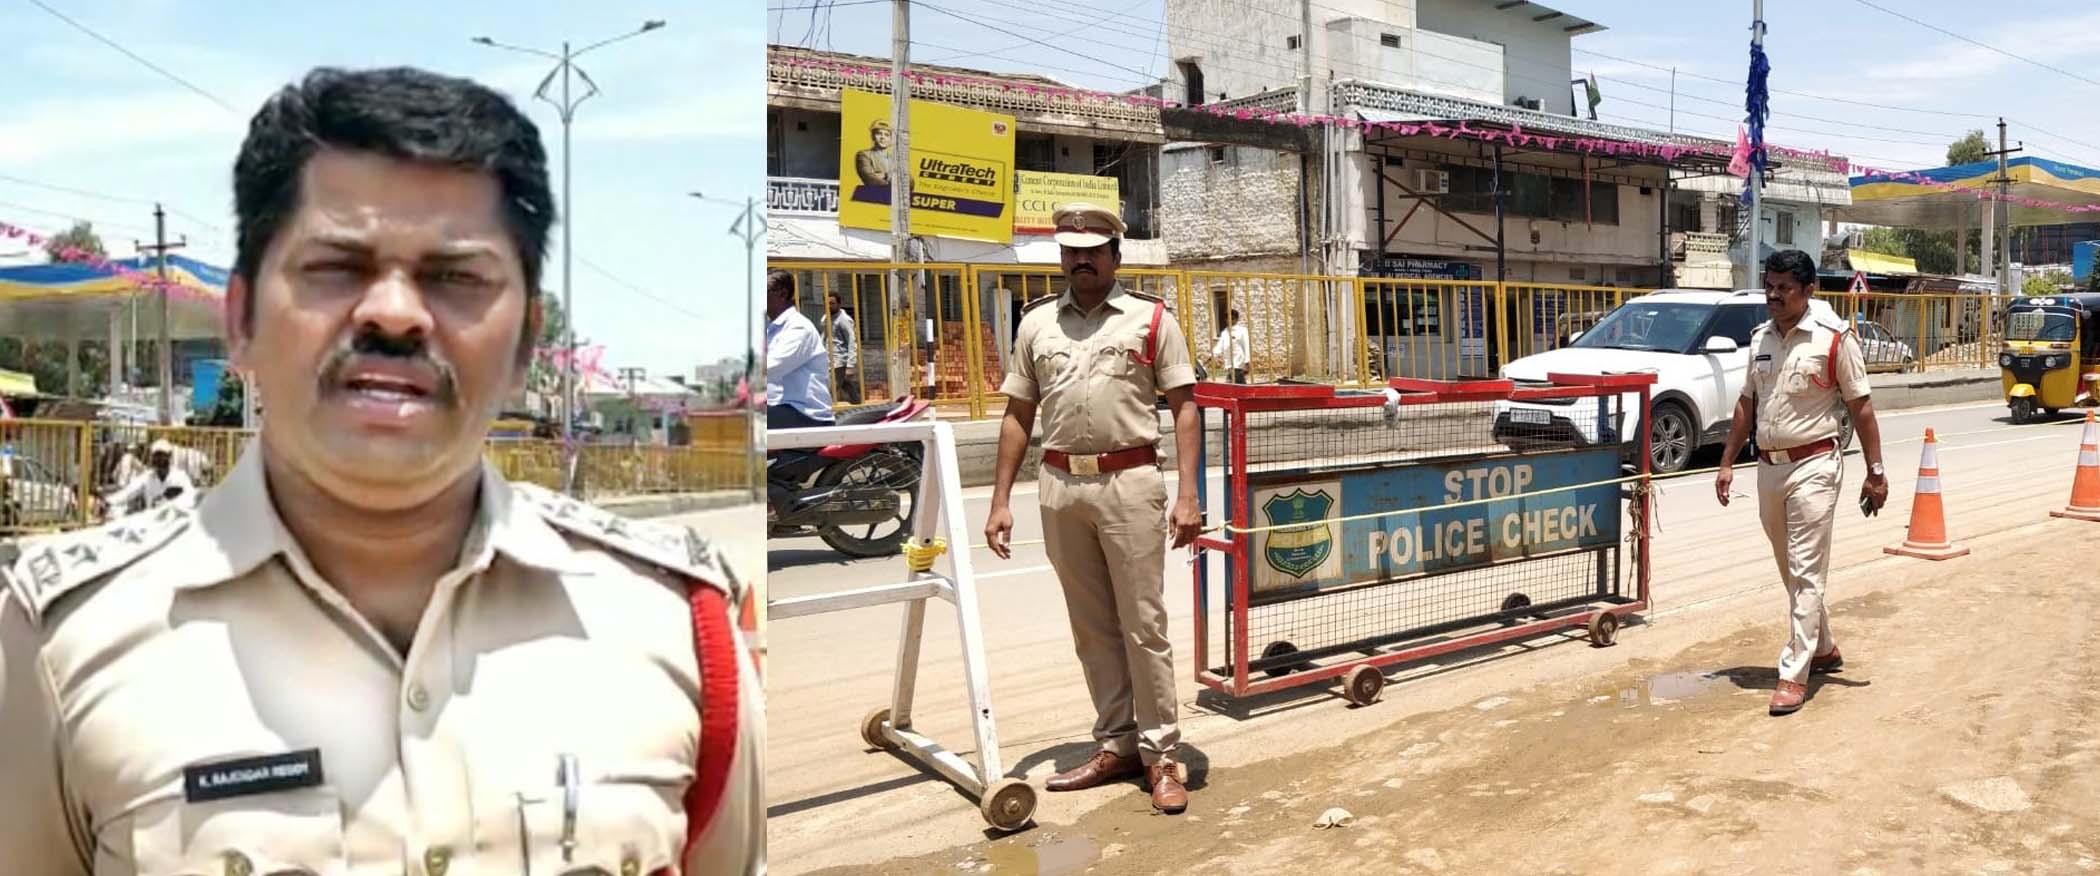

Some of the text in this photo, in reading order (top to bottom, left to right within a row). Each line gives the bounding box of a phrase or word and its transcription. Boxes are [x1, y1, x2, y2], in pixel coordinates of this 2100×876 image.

[920, 158, 996, 179] UltraTech
[912, 196, 956, 210] SUPER
[1023, 200, 1046, 212] CCI
[1392, 259, 1406, 268] SAI
[1407, 260, 1448, 269] PHARMACY
[1444, 464, 1533, 503] STOP
[1369, 520, 1487, 569] POLICE
[1502, 504, 1598, 549] CHECK
